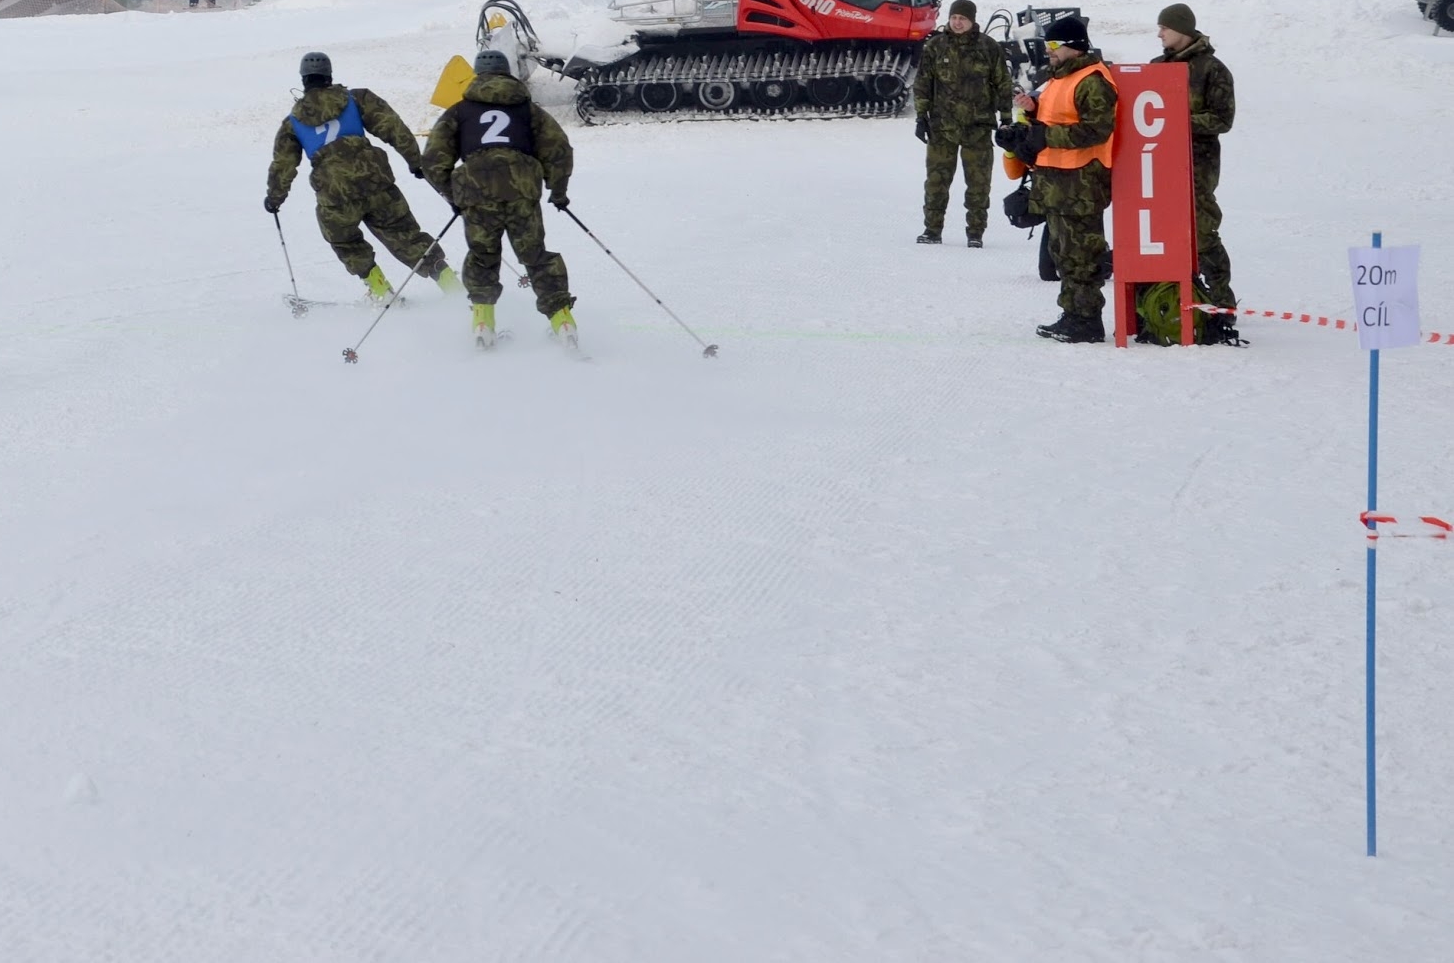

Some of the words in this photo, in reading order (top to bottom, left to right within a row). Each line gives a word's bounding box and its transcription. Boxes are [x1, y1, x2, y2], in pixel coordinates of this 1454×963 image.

[480, 109, 511, 145] 2
[1132, 90, 1165, 255] CÍL
[1357, 265, 1397, 286] 20m
[1363, 301, 1390, 327] CÍL
